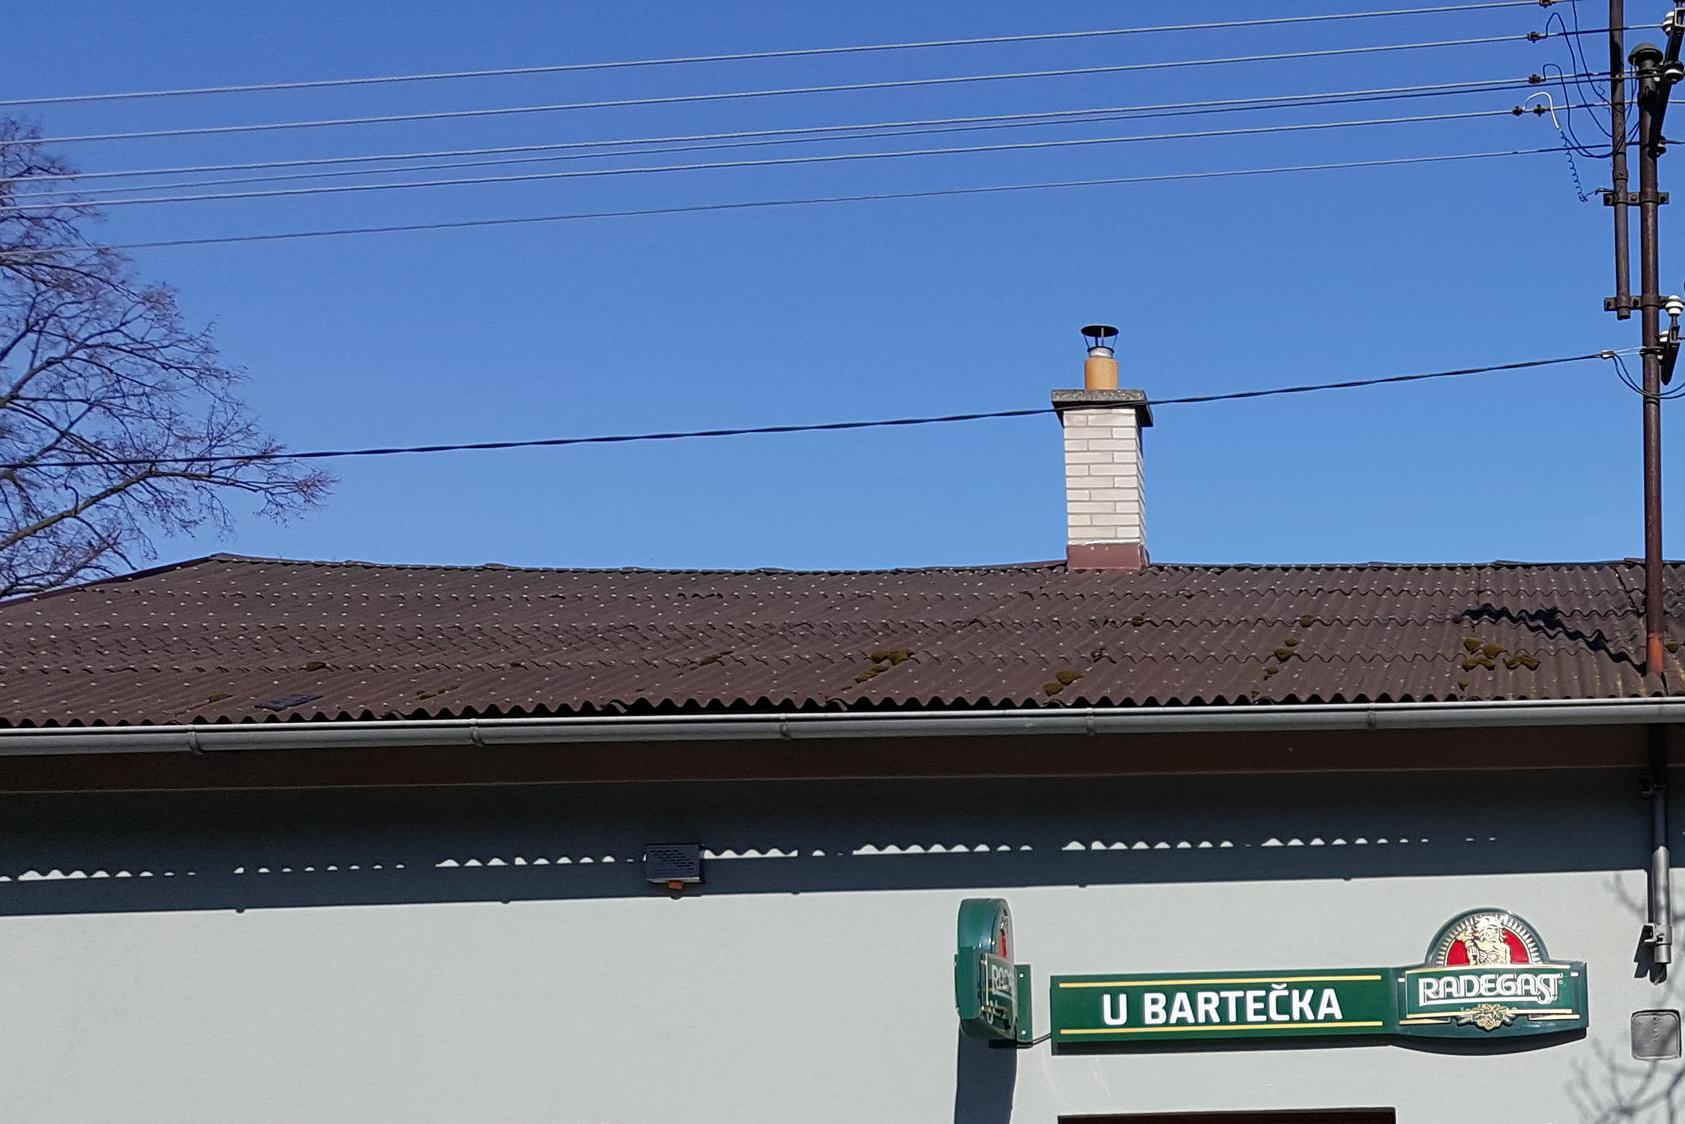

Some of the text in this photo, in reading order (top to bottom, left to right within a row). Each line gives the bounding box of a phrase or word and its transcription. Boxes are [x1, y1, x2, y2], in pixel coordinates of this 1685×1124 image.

[1103, 983, 1343, 1026] U BARTEČKA
[1418, 972, 1564, 1007] RADEGAST
